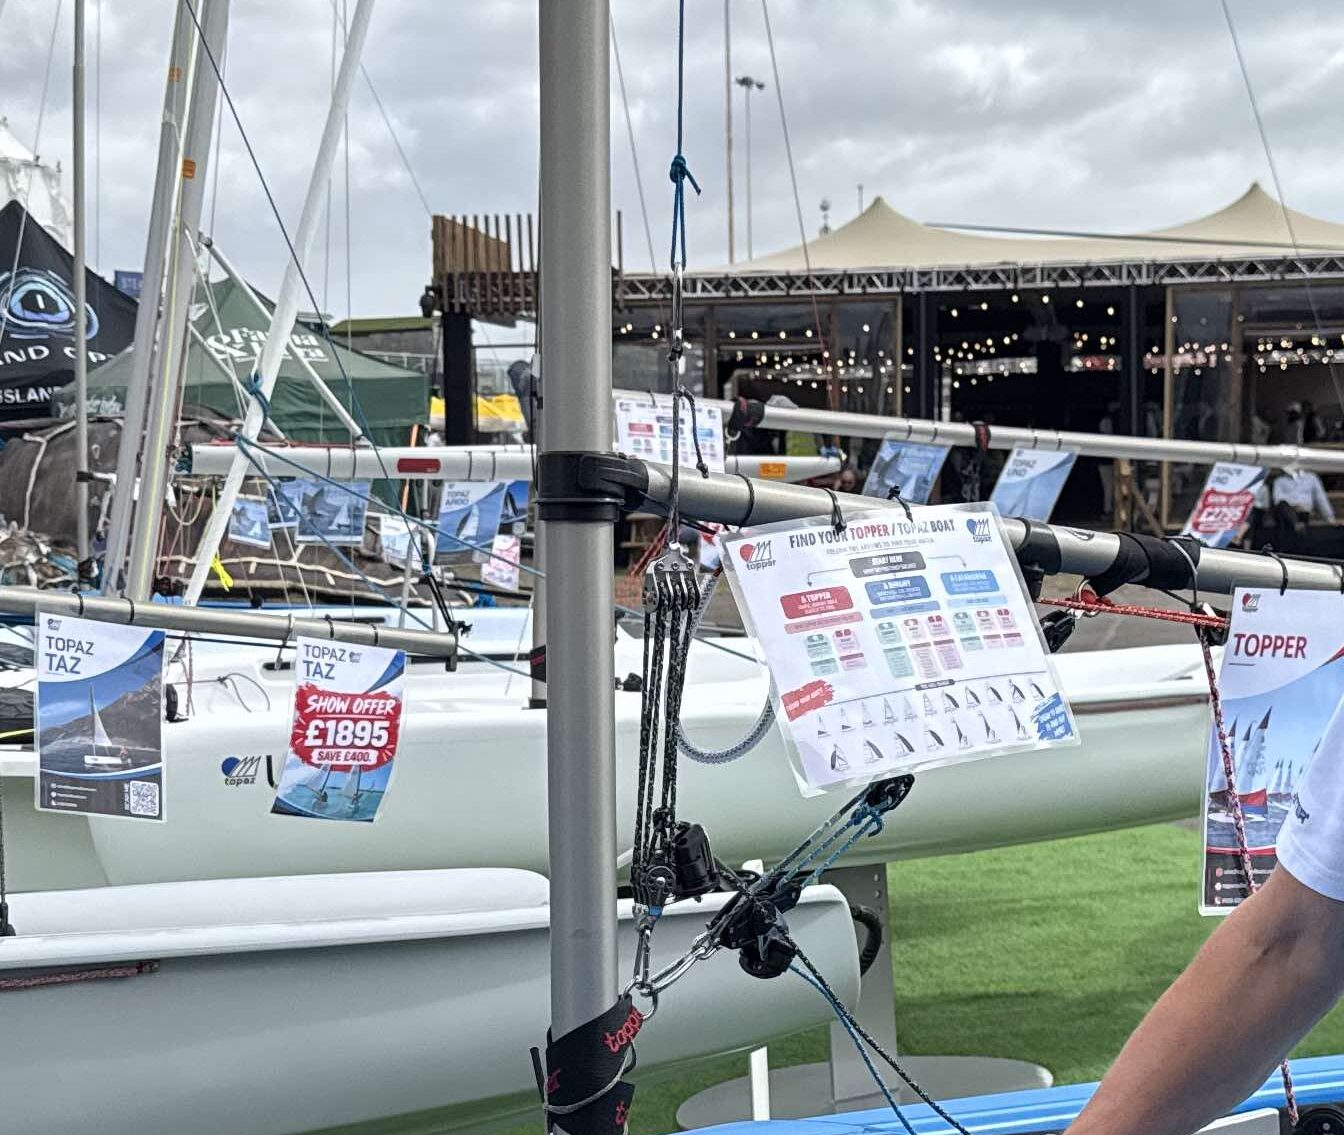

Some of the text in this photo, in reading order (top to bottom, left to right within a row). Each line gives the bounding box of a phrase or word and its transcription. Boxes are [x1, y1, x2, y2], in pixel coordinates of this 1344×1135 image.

[789, 533, 817, 548] FIND
[820, 530, 849, 545] YOUR
[850, 524, 889, 541] TOPPER
[930, 518, 956, 533] BOAT
[746, 559, 776, 571] topper
[45, 636, 95, 656] TOPAZ
[303, 643, 347, 663] TOPAZ
[1233, 632, 1308, 660] TOPPER
[45, 653, 82, 675] TAZ
[303, 660, 335, 681] TAZ
[304, 694, 396, 715] SHOW OFFER
[305, 719, 391, 748] £1895
[317, 750, 342, 762] SAVE
[224, 777, 256, 787] topaz
